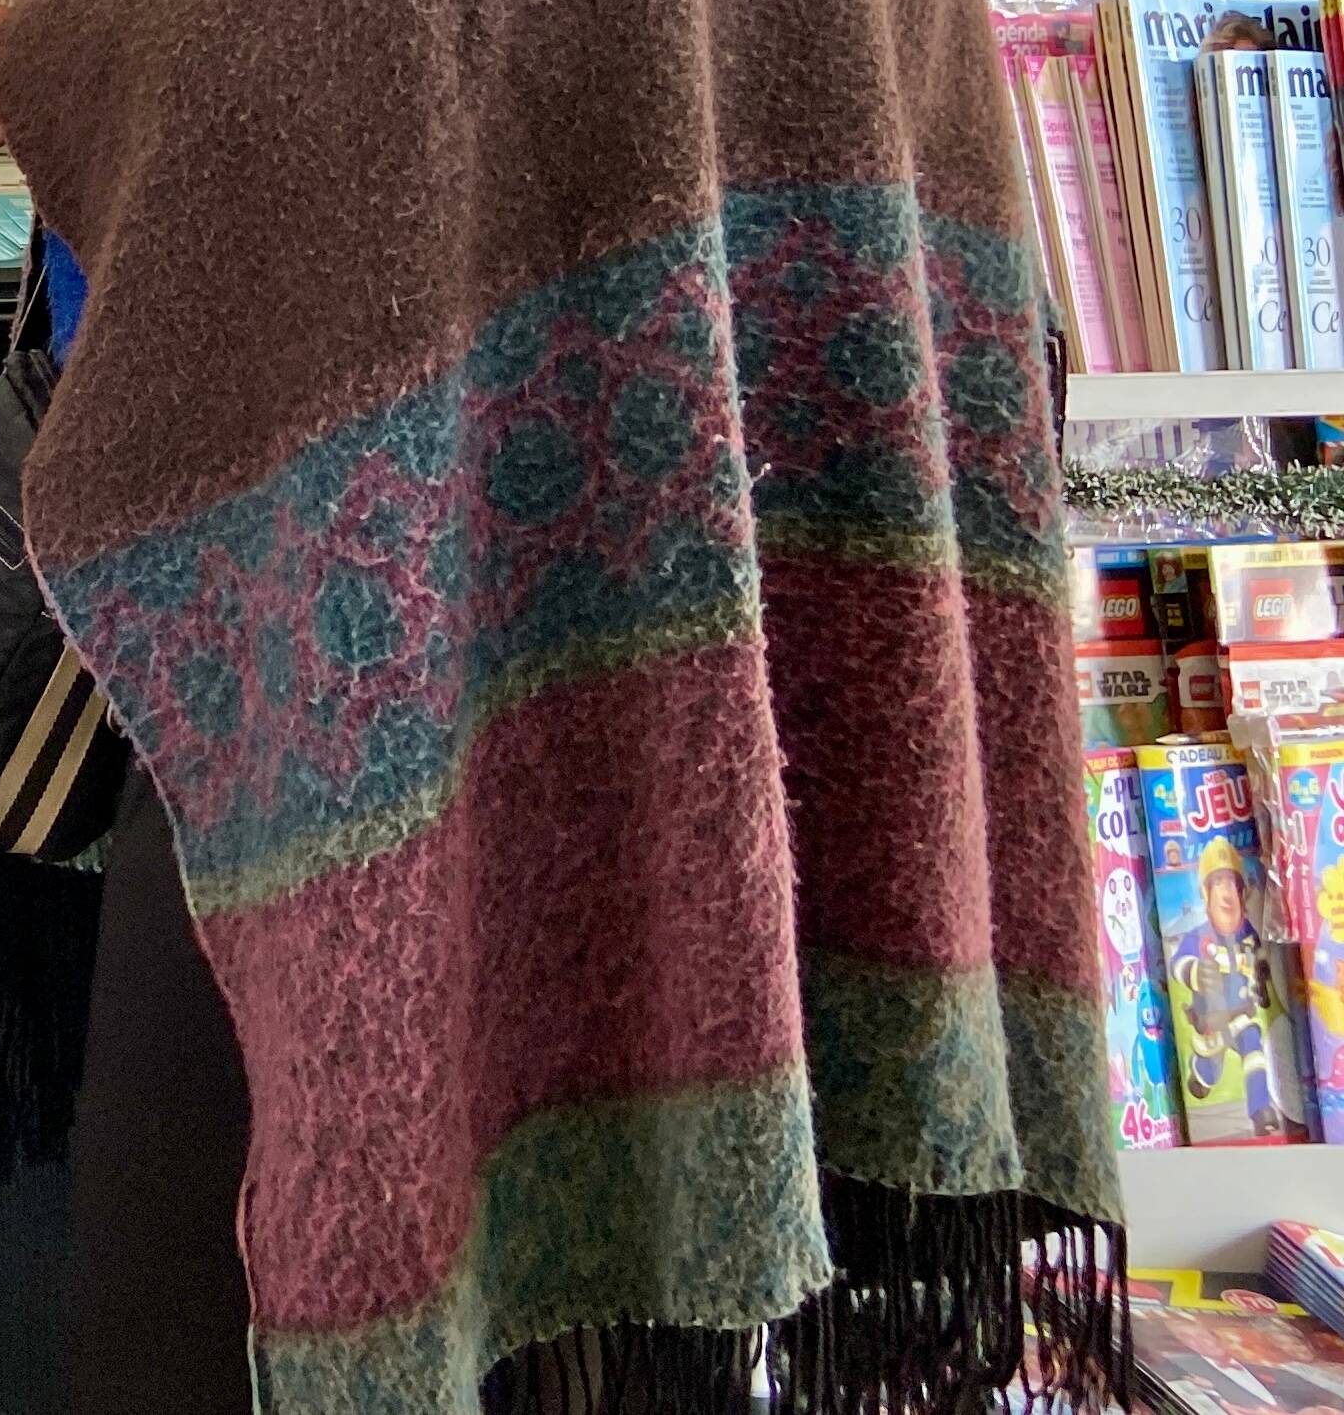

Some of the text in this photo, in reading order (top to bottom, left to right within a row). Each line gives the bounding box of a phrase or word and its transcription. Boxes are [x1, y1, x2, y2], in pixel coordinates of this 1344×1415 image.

[1169, 206, 1202, 243] 30
[1302, 237, 1331, 268] 30
[1100, 596, 1138, 619] LEGO
[1255, 596, 1294, 619] LEGO
[1097, 670, 1151, 685] STAR
[1119, 1098, 1154, 1144] 46
